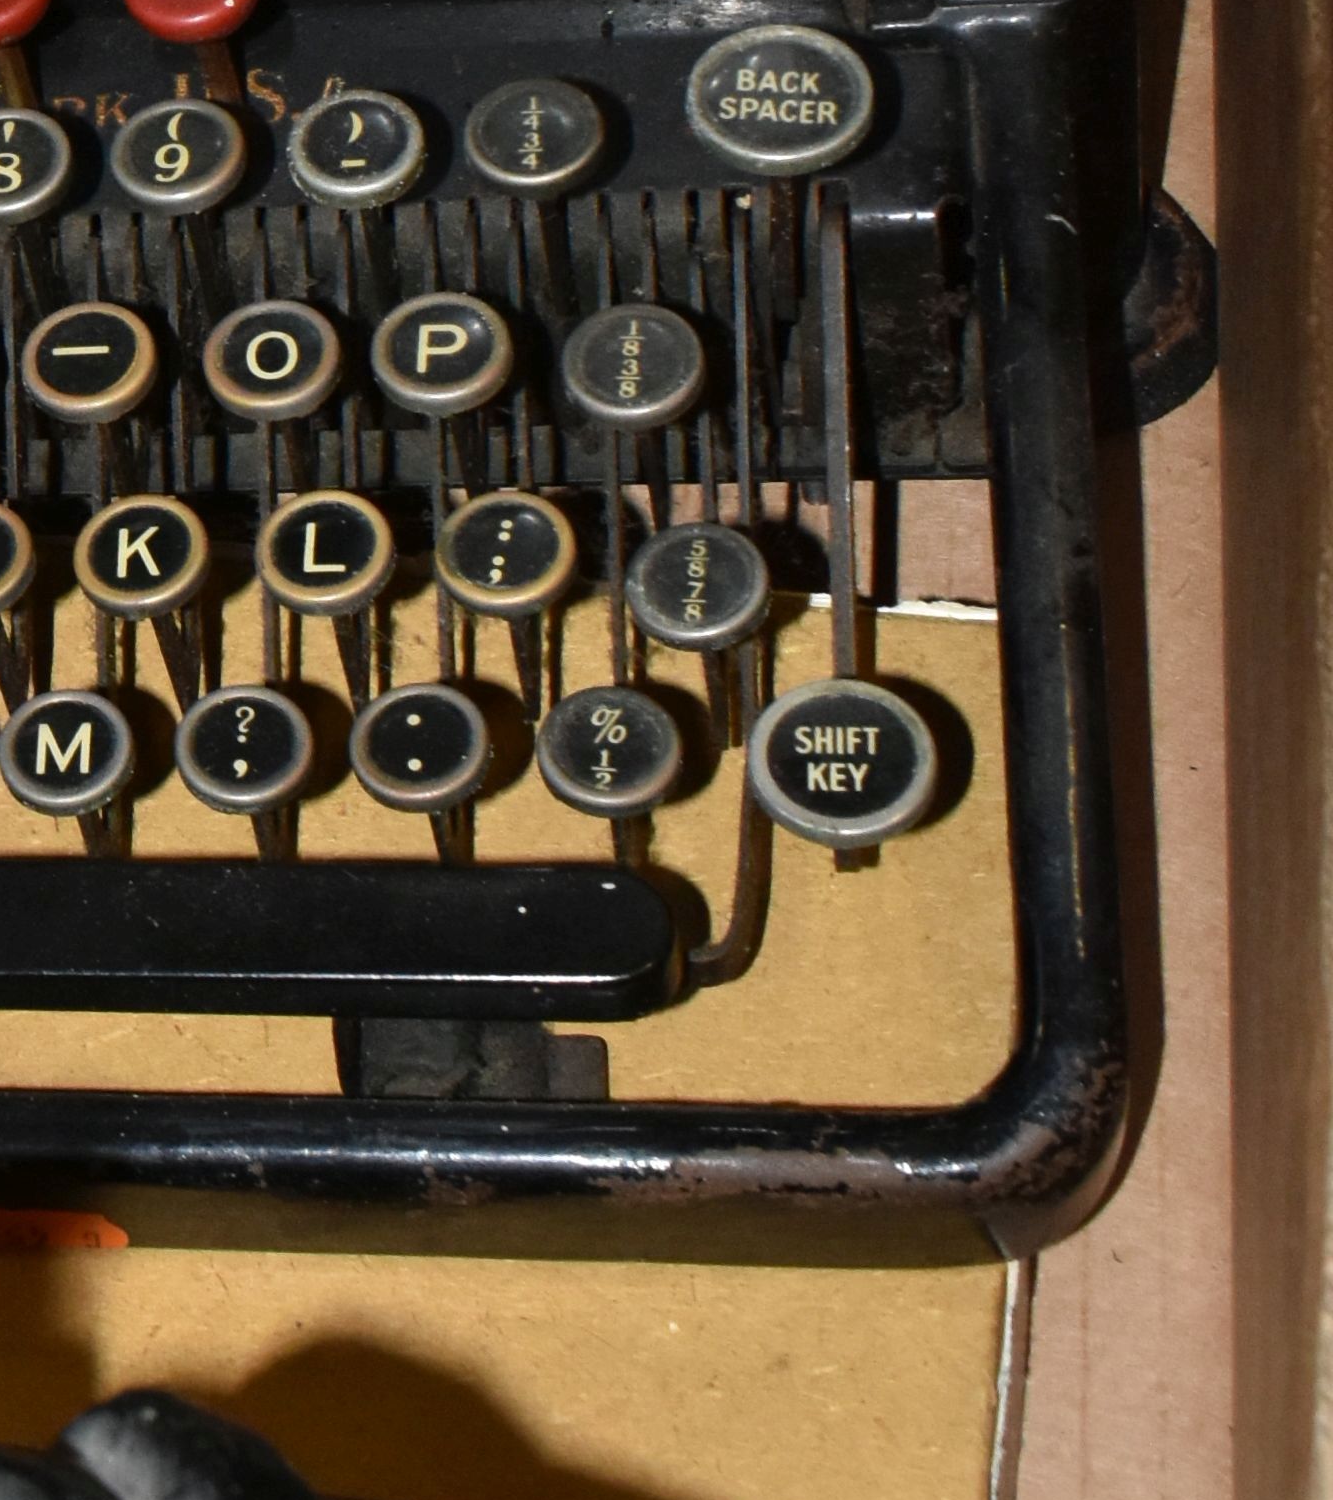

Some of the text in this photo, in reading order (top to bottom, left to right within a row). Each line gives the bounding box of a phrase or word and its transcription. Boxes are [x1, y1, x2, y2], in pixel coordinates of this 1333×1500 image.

[735, 69, 822, 95] BACK
[718, 97, 838, 126] SPACER
[154, 143, 189, 183] 9
[245, 330, 298, 380] O
[416, 323, 468, 374] P
[116, 526, 161, 578] K
[303, 522, 346, 573] L
[35, 722, 92, 775] M
[793, 724, 881, 758] SHIFT
[805, 761, 871, 794] KEY
